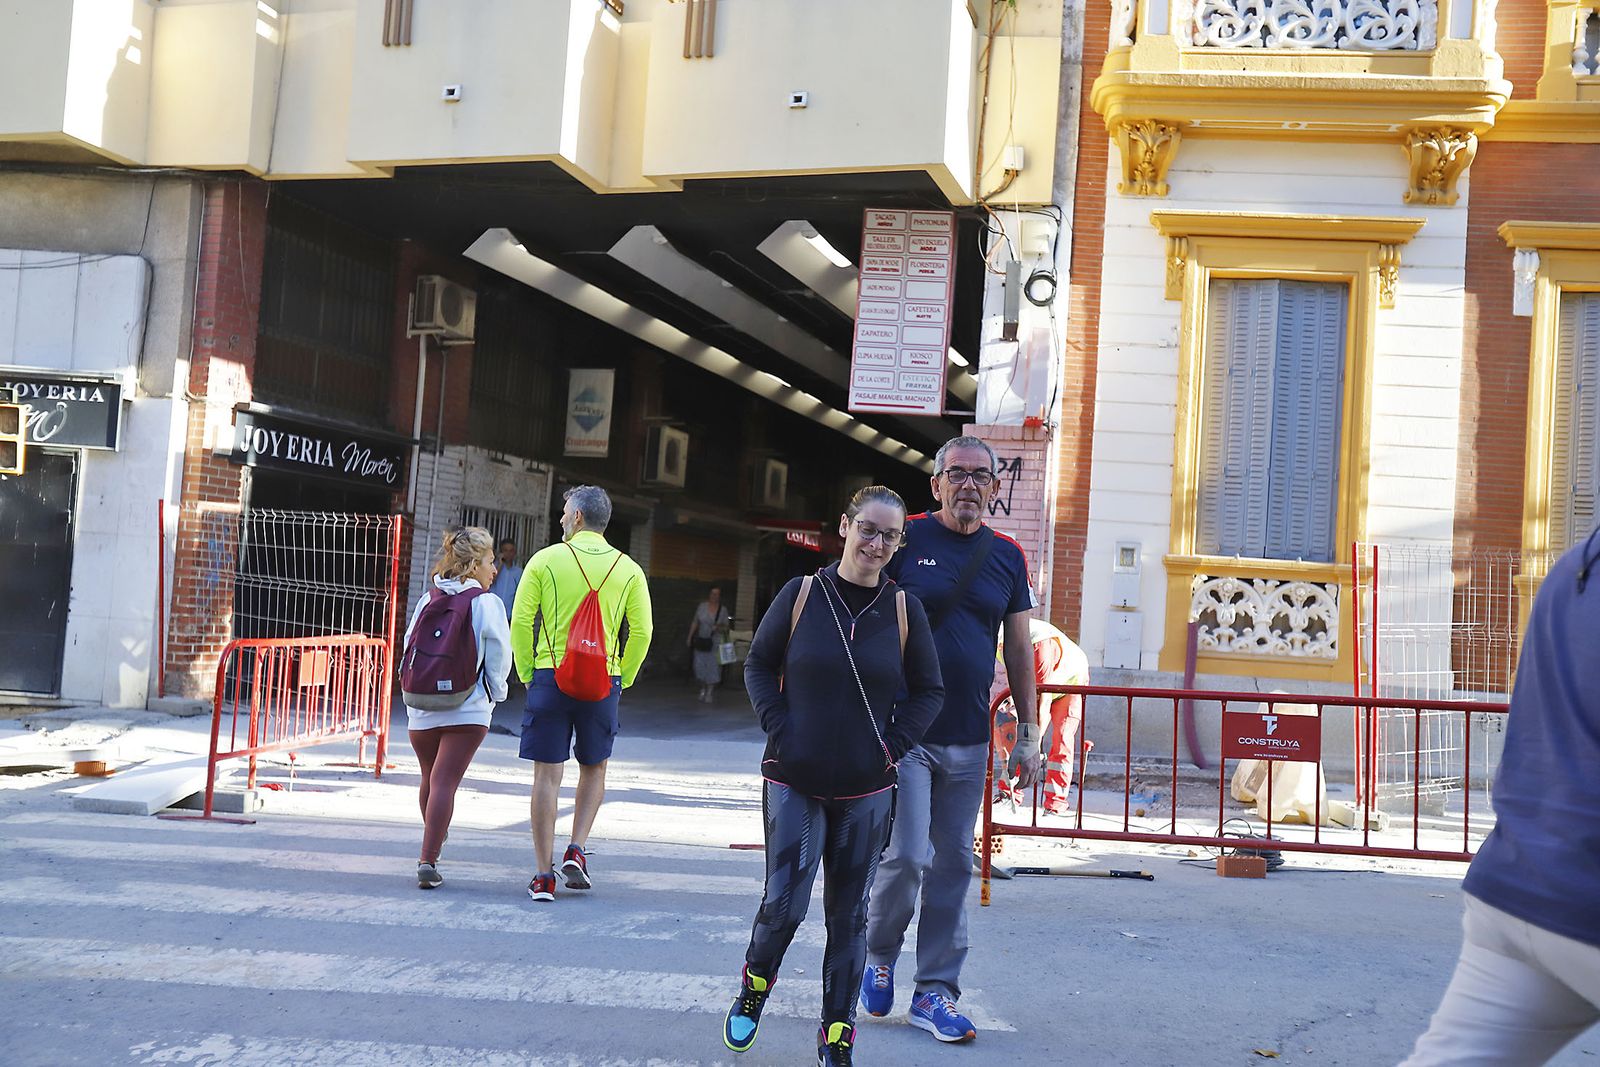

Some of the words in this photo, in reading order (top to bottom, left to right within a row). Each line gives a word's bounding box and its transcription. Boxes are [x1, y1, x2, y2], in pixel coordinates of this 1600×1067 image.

[910, 261, 945, 269] FLORISTERIA
[860, 329, 894, 337] ZAPATERO
[902, 374, 936, 382] ESTETICA
[855, 392, 878, 400] PASAJE
[904, 395, 935, 403] MACHADO
[240, 424, 334, 468] JOYERIA
[917, 557, 937, 566] FILA
[1238, 737, 1300, 748] CONSTRUYA
